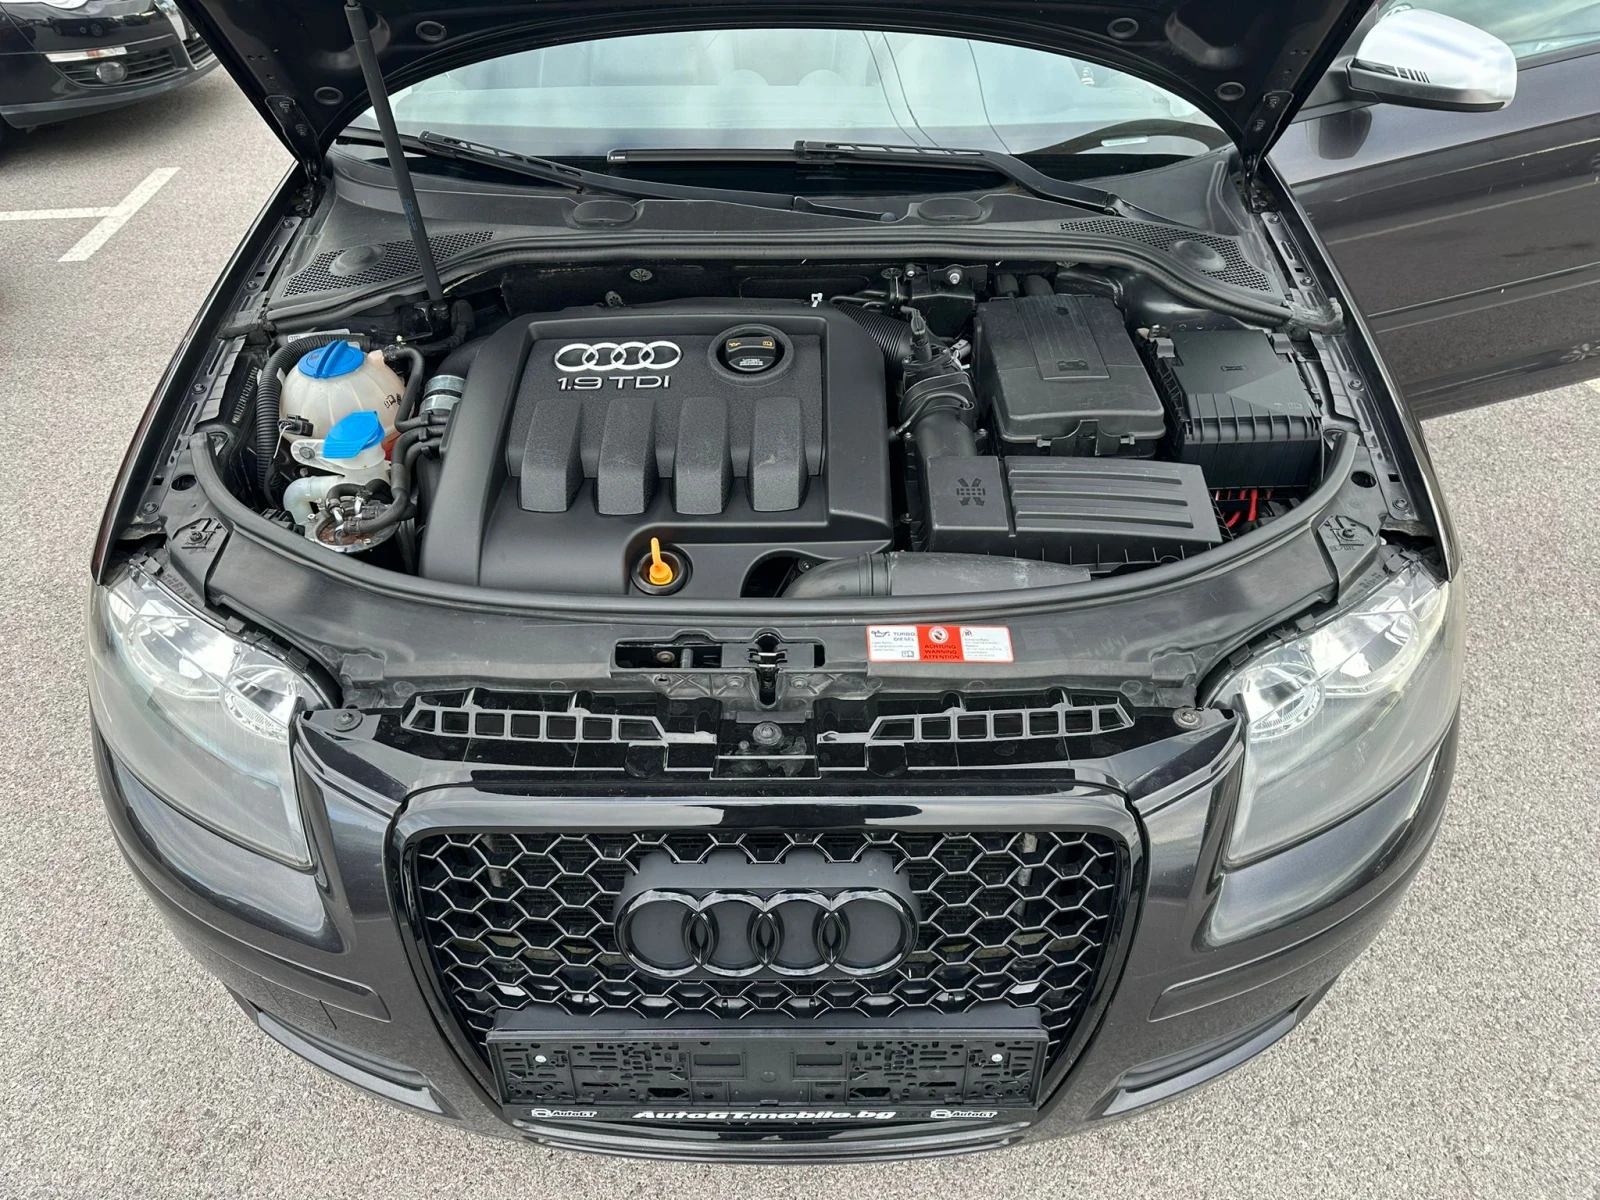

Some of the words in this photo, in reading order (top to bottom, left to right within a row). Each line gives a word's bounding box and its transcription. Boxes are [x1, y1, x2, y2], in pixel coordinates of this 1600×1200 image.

[557, 377, 602, 391] 1.9
[608, 375, 671, 390] TDI
[632, 1110, 897, 1120] AutoGT.mobile.bg
